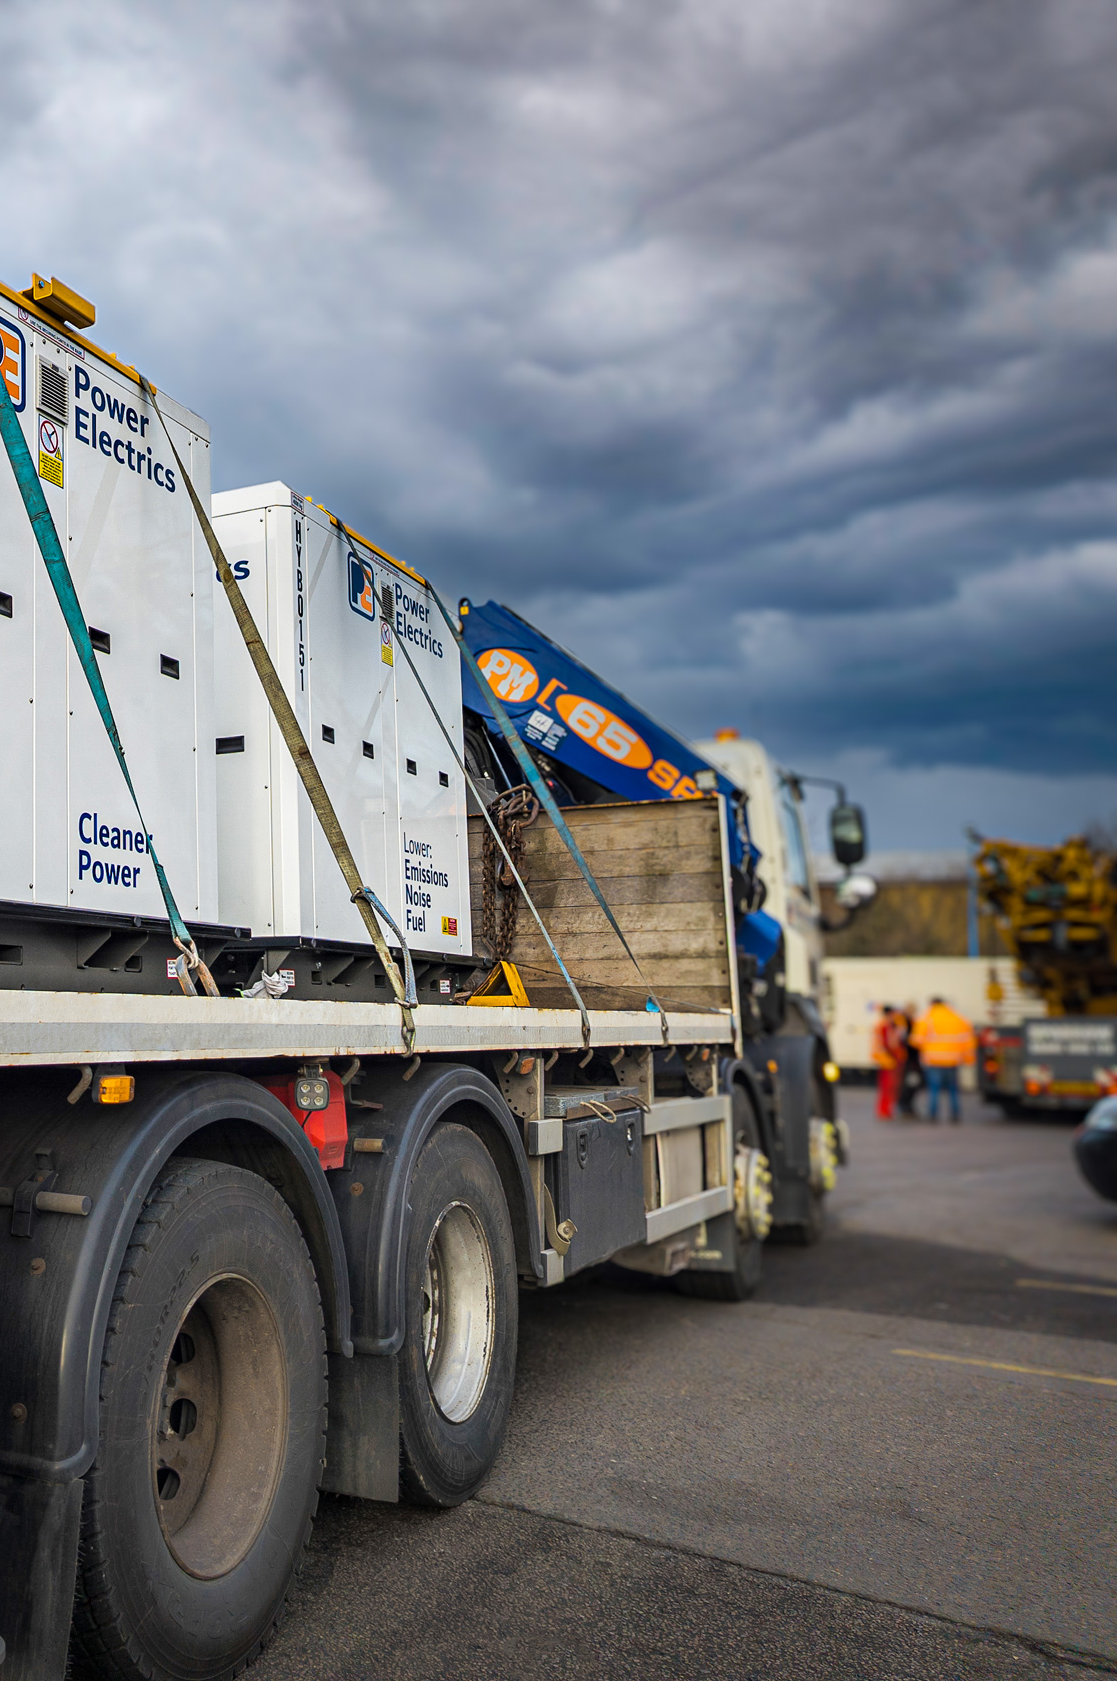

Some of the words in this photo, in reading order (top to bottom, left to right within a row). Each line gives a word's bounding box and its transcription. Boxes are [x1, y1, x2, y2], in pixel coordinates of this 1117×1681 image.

[74, 364, 150, 438] Power
[74, 405, 176, 493] Electrics
[395, 582, 430, 624] Power
[395, 611, 444, 659] Electrics
[481, 650, 536, 701] PM
[567, 702, 640, 760] 65
[79, 812, 153, 854] Cleaner
[404, 832, 432, 859] Lower:
[79, 849, 140, 888] Power
[405, 859, 448, 888] Emissions
[405, 884, 431, 908] Noise
[406, 909, 426, 932] Fuel
